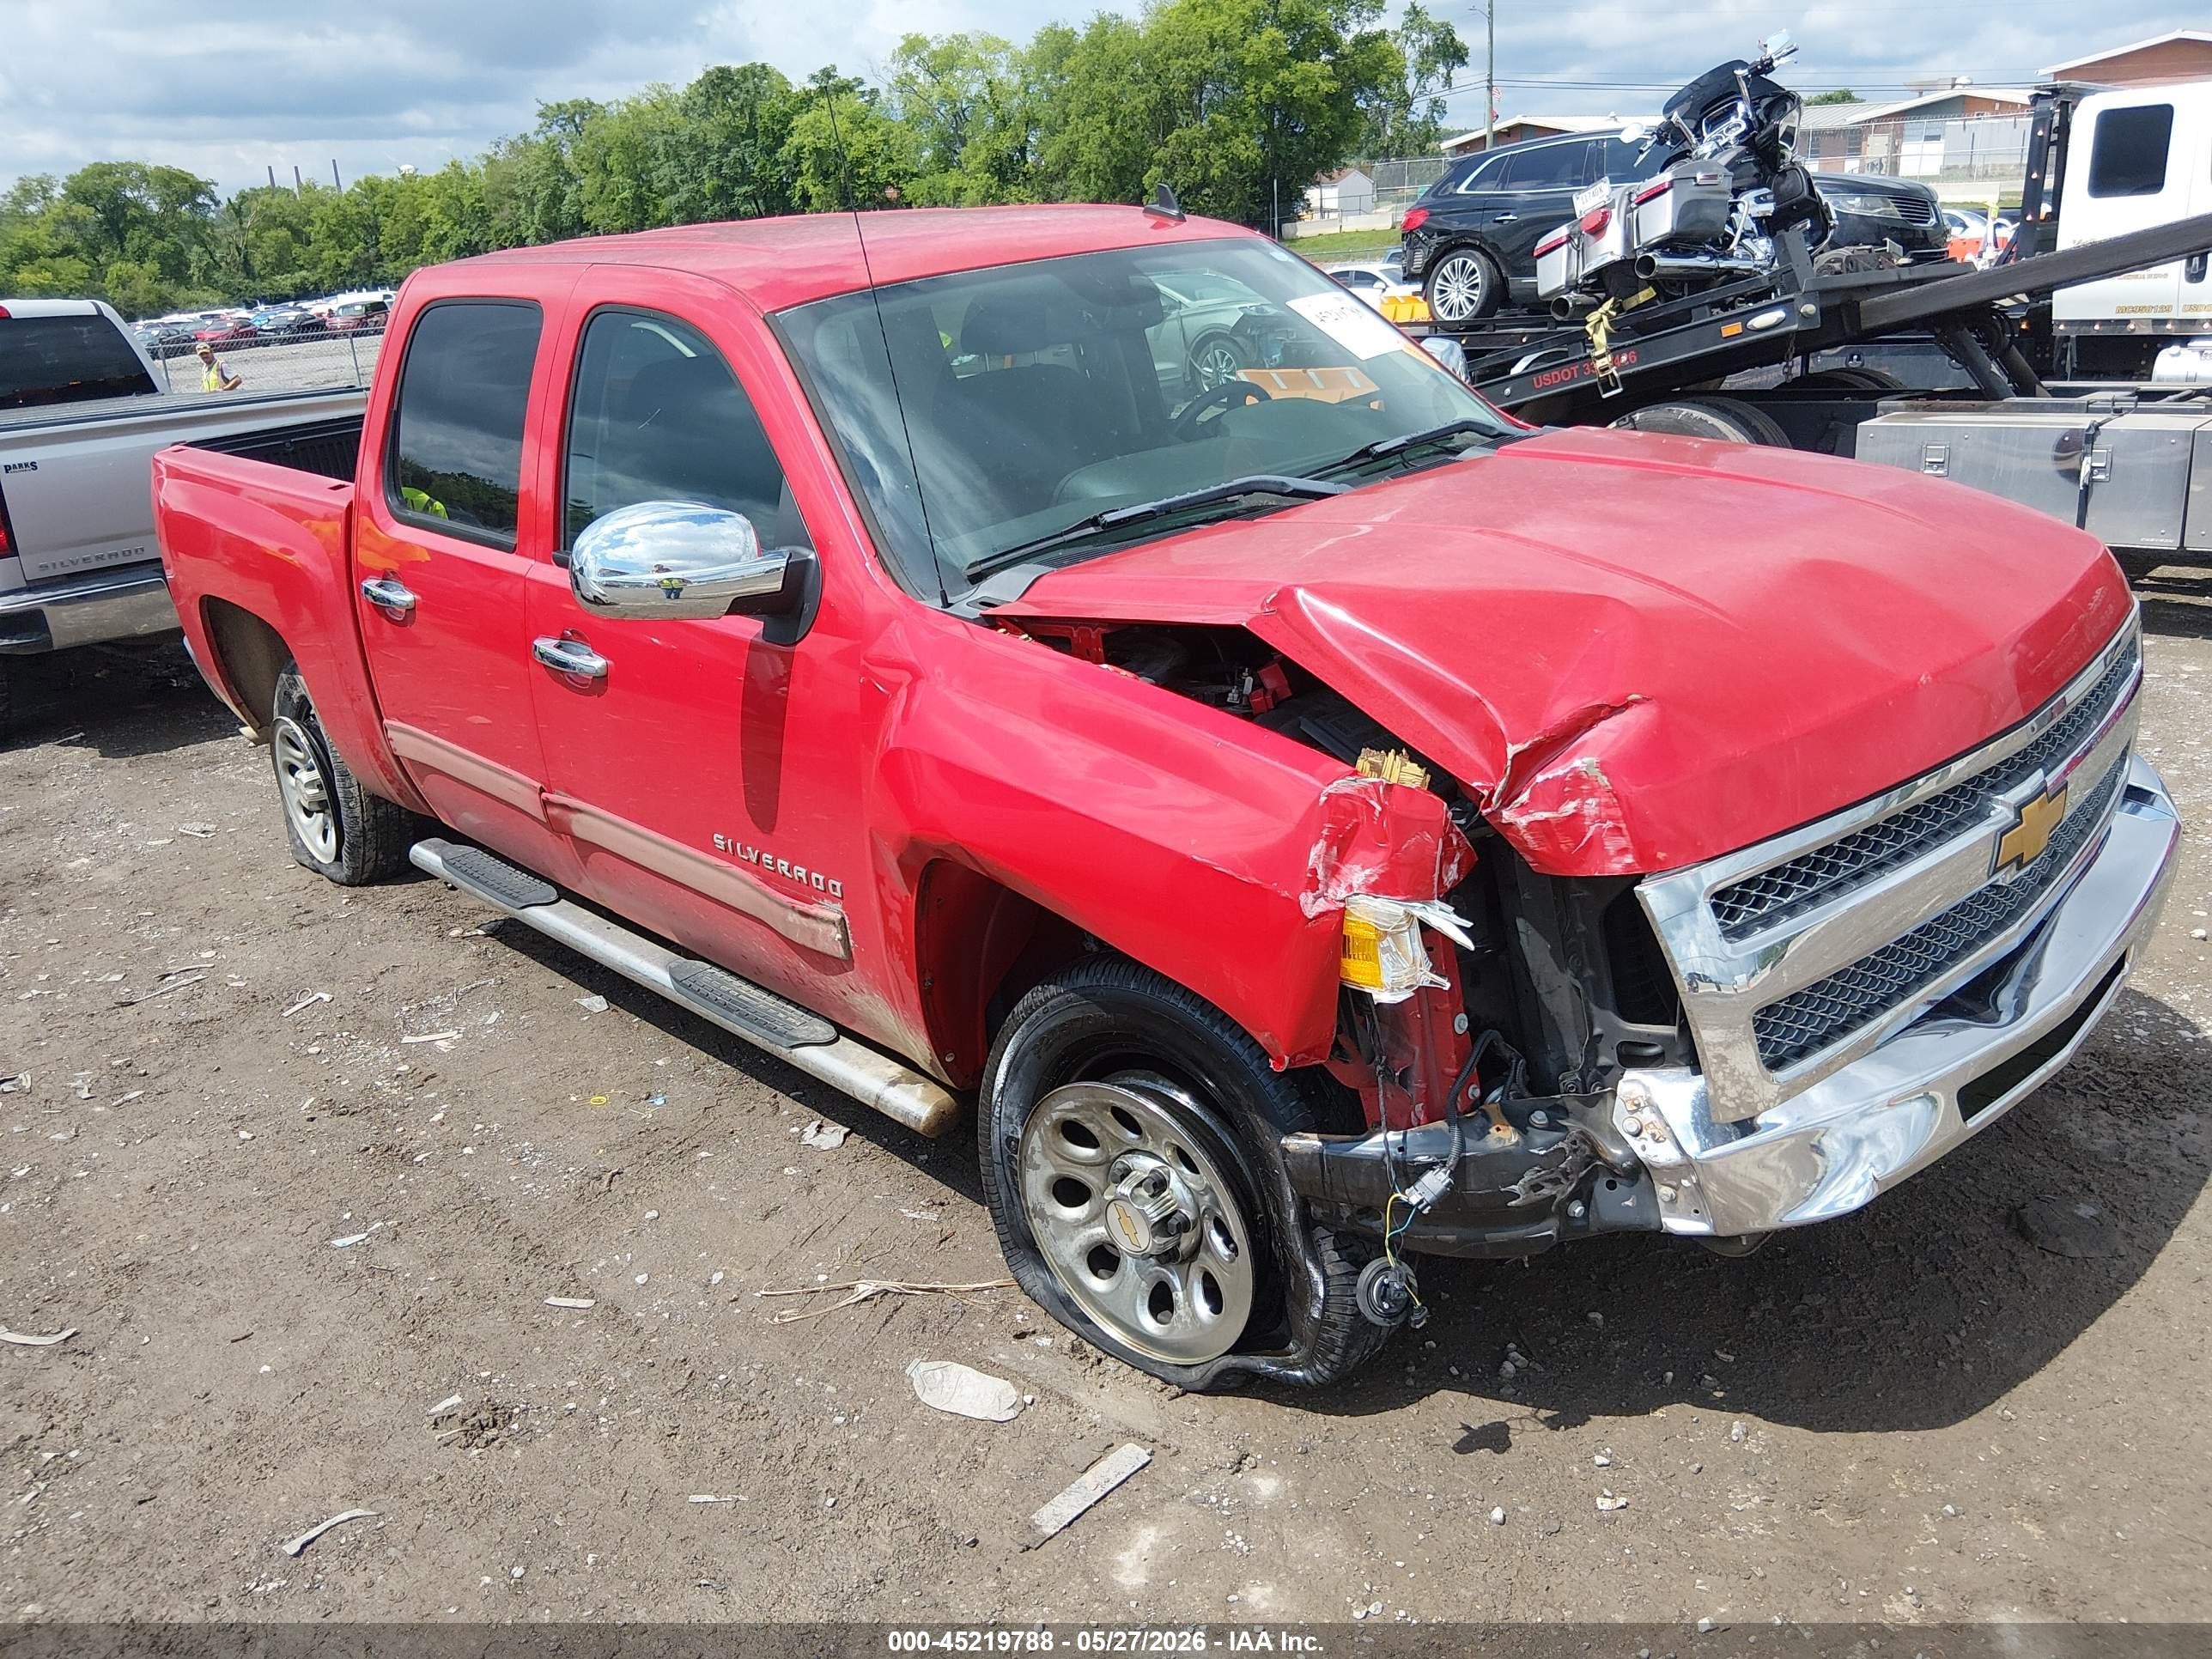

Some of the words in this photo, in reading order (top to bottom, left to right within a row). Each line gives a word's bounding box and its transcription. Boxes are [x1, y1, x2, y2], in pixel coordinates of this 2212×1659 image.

[1533, 364, 1579, 389] USDOT
[3, 461, 38, 474] PARKS
[38, 545, 145, 571] SILVERADO
[714, 833, 843, 898] SILVERADO
